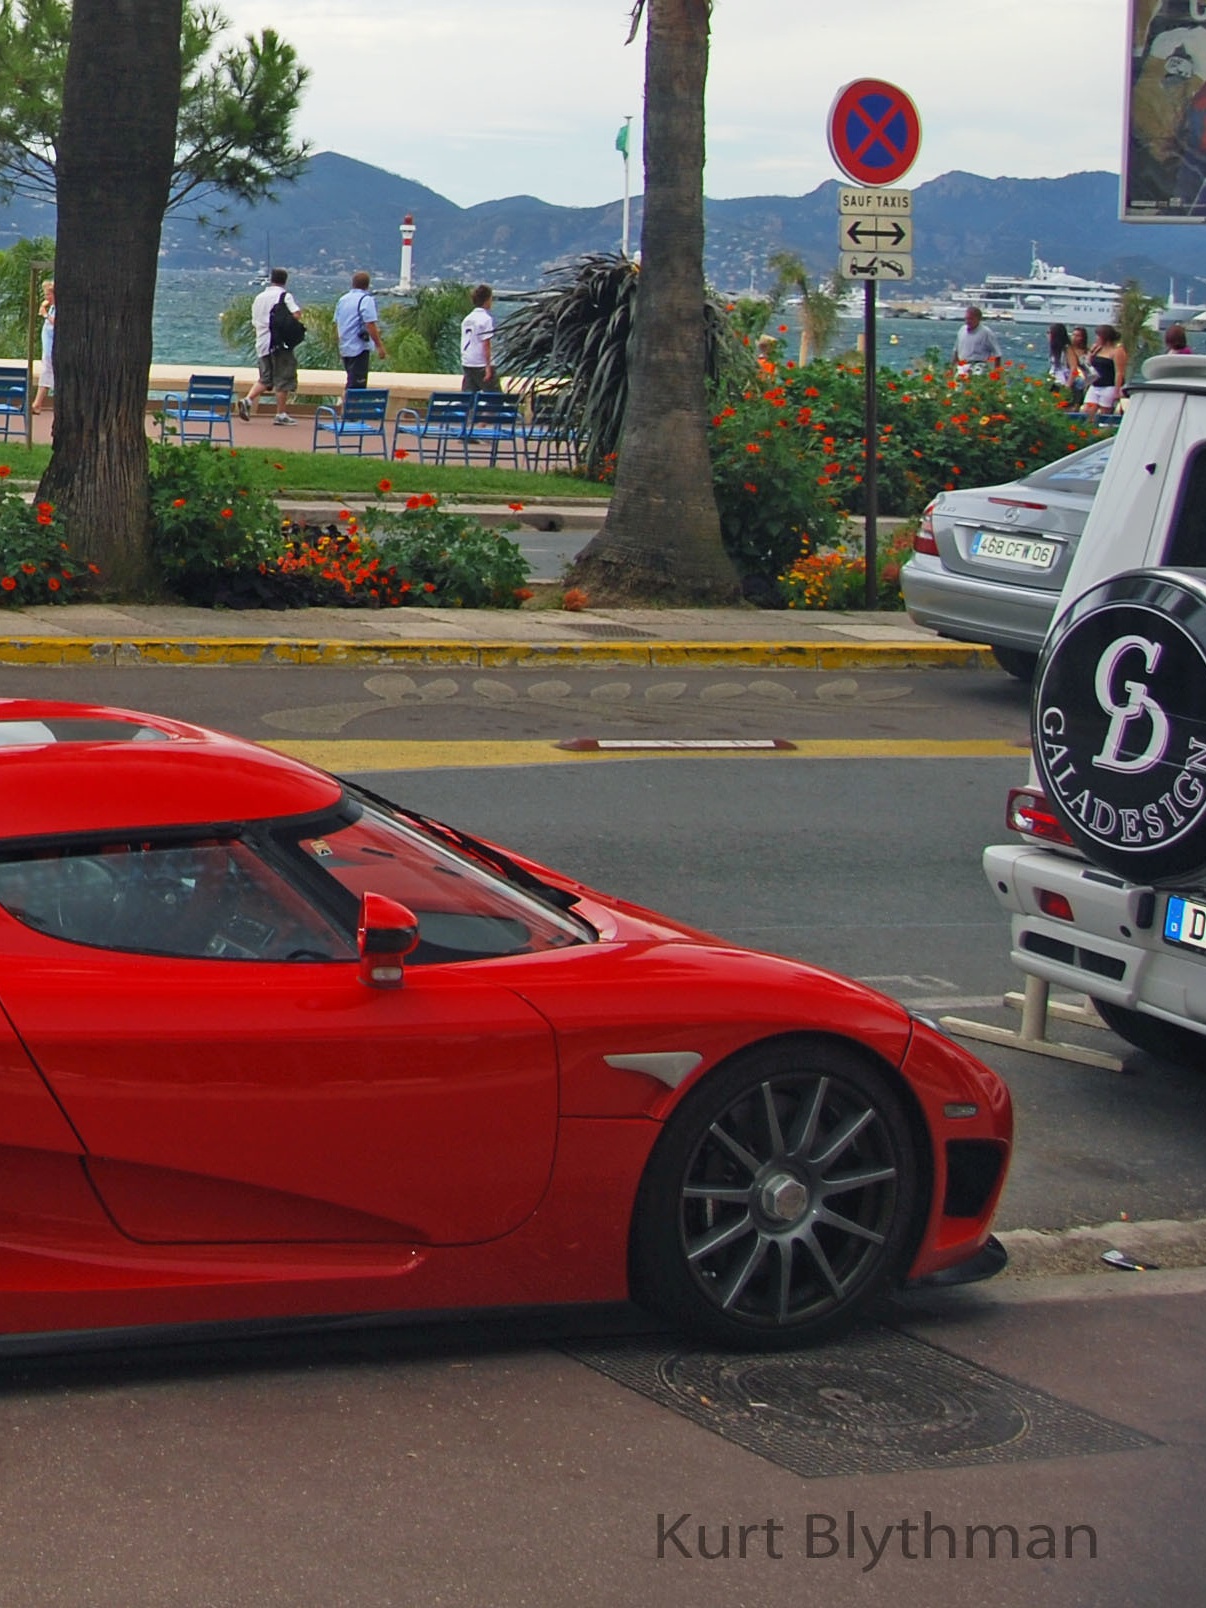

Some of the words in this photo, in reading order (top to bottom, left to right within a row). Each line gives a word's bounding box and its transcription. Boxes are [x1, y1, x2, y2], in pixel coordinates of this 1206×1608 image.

[843, 195, 872, 207] SAUF
[876, 196, 909, 208] TAXIS
[980, 537, 1005, 554] 468
[1032, 546, 1050, 562] 06
[1093, 635, 1170, 775] GD
[1042, 707, 1206, 843] GALADESIGN
